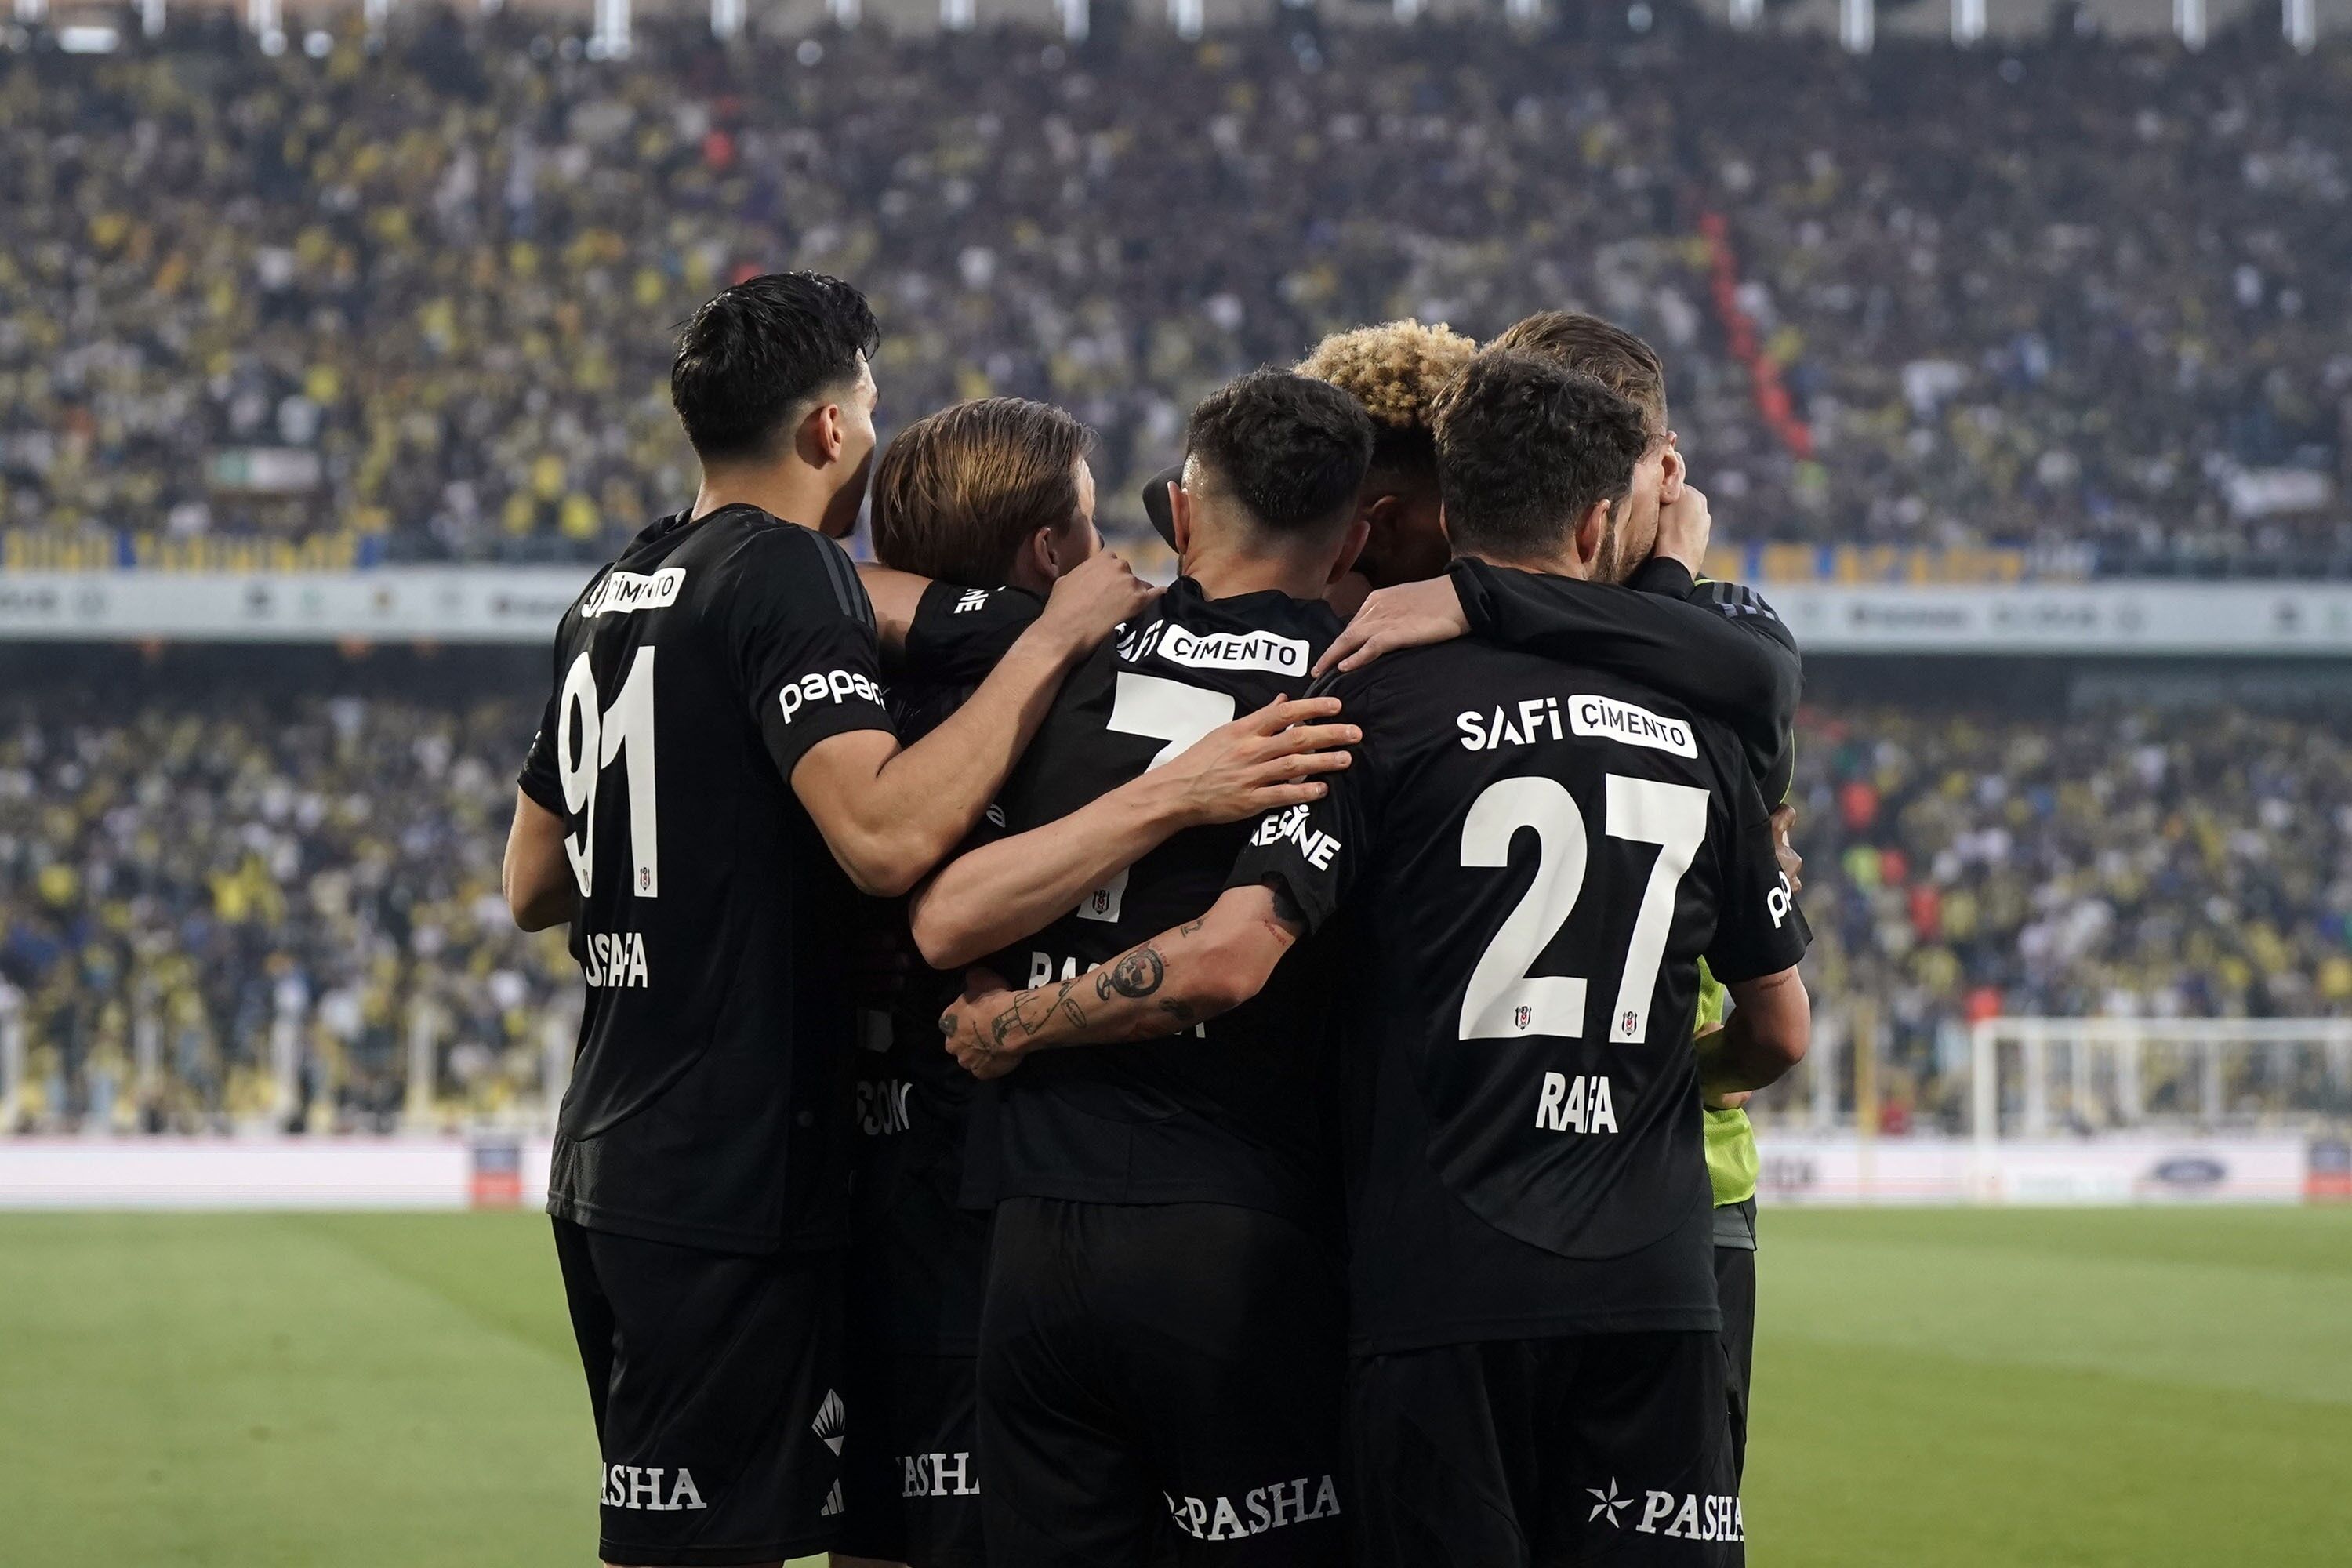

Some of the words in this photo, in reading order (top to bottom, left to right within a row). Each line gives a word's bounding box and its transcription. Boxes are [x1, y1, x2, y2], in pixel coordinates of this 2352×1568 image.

[557, 645, 658, 898] 91
[779, 670, 887, 724] papar
[1076, 671, 1236, 923] 7
[1458, 773, 1711, 1044] 27
[1535, 1071, 1619, 1134] RAFA
[1185, 1474, 1341, 1541] PASHA
